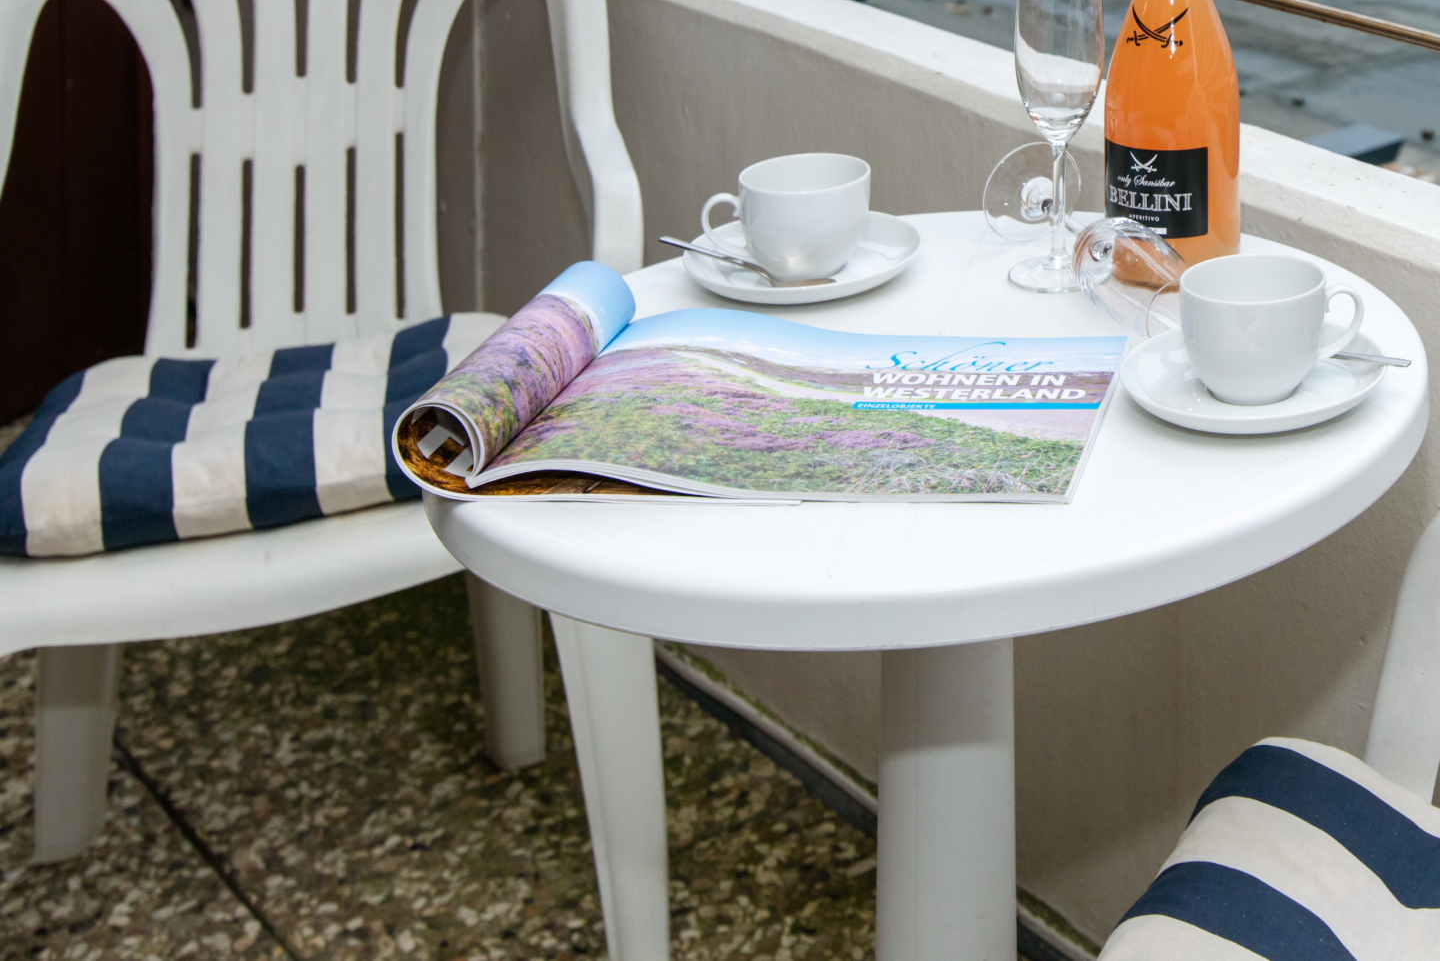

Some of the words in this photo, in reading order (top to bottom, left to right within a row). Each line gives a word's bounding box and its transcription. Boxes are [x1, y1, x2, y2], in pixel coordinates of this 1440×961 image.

[1117, 174, 1132, 187] only
[1133, 174, 1175, 187] Sansibar
[1109, 185, 1193, 211] BELLINI
[1129, 214, 1160, 222] APERITIVO
[866, 341, 1054, 372] Schöner
[872, 373, 1020, 386] WOHNEN
[1030, 374, 1066, 386] IN
[864, 386, 1086, 400] WESTERLAND
